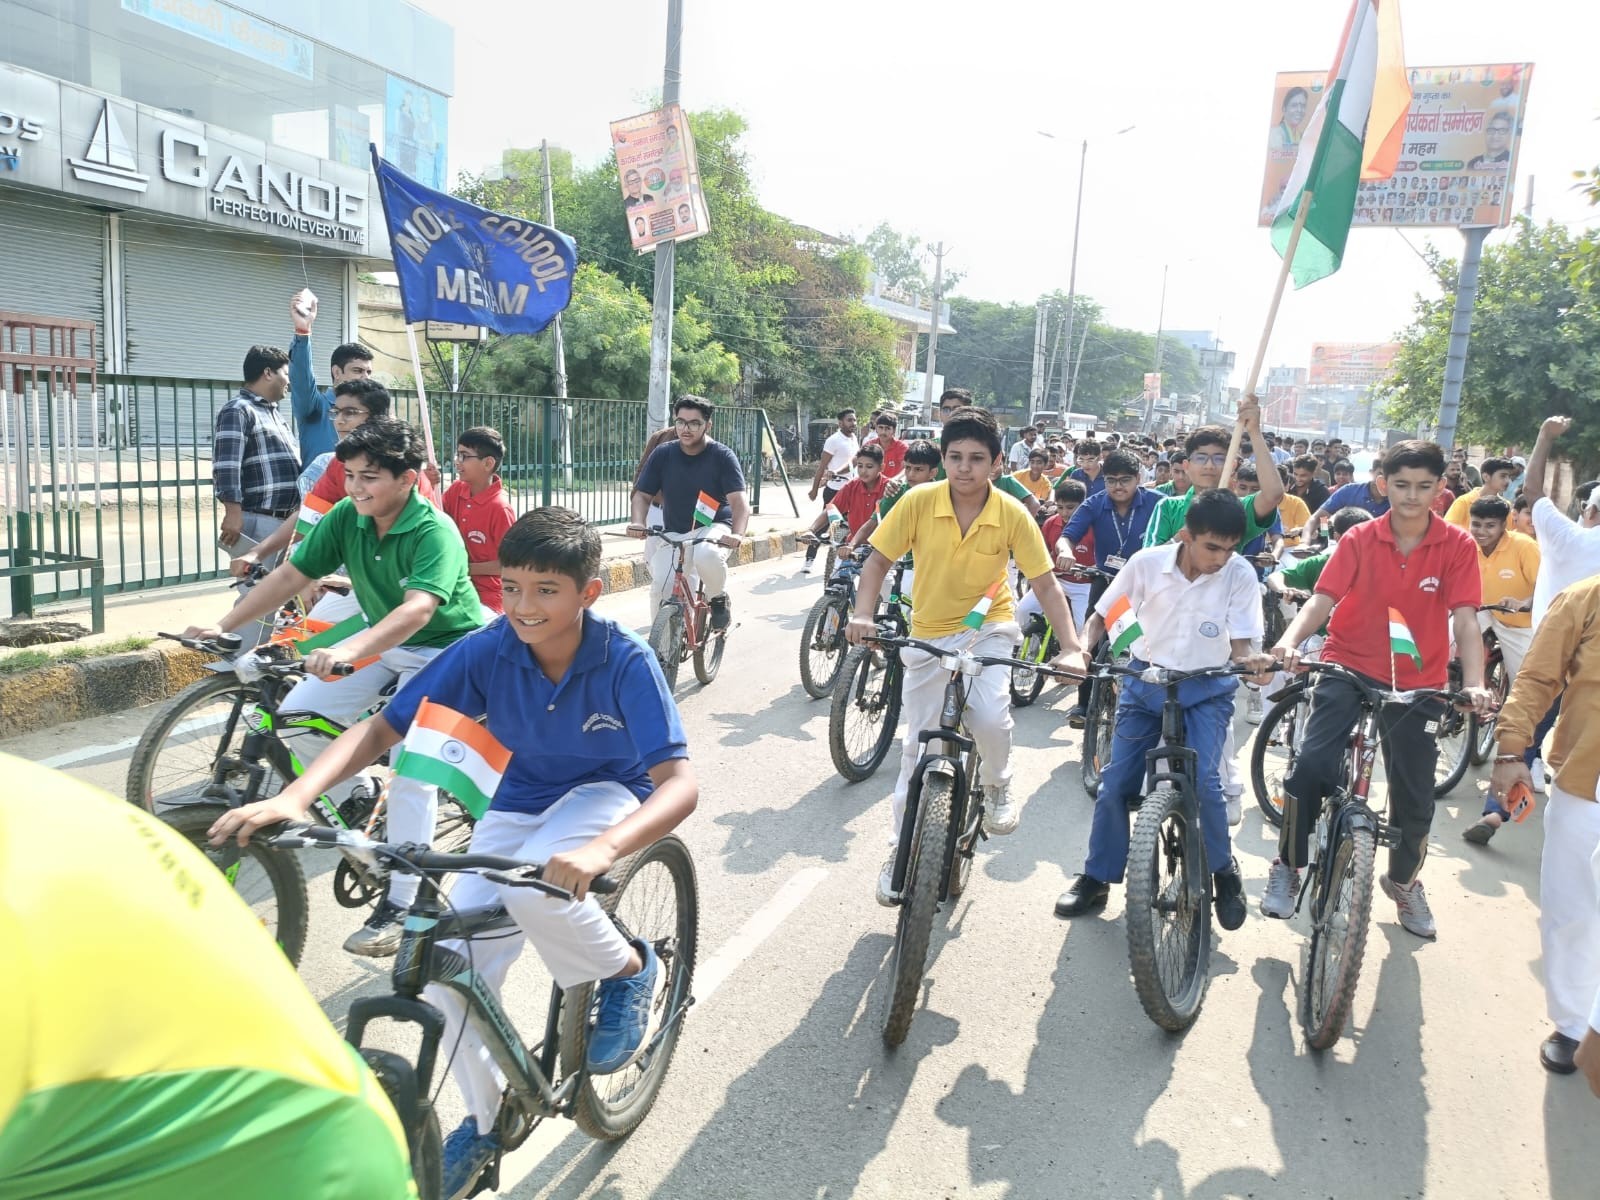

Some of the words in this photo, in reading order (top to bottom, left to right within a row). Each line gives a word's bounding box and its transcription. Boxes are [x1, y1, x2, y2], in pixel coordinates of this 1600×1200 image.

[1442, 104, 1486, 133] सम्मेलन
[1407, 142, 1439, 157] महम
[161, 128, 369, 229] CANOE
[211, 196, 299, 231] PERFECTION
[299, 219, 340, 239] EVERY
[341, 228, 366, 245] TIME
[479, 216, 569, 293] SCHOOL
